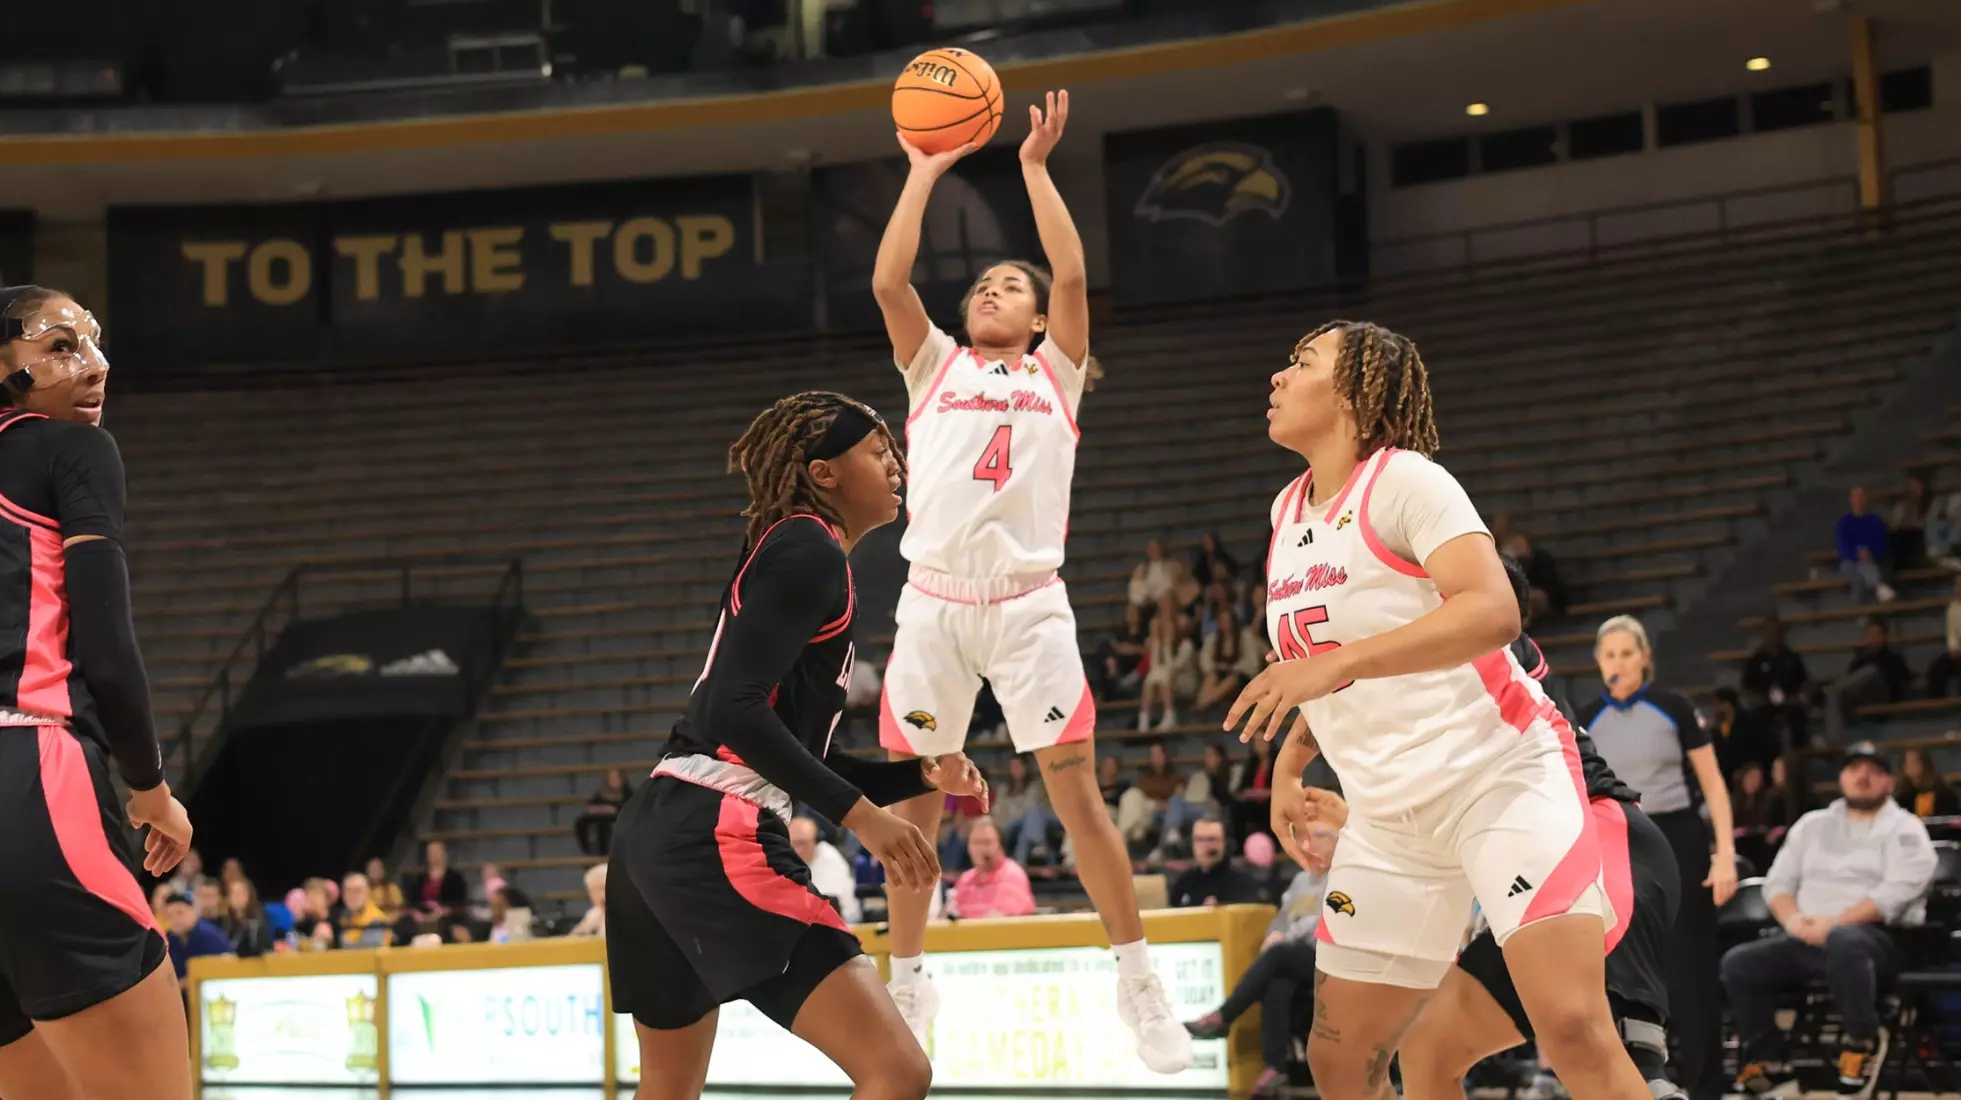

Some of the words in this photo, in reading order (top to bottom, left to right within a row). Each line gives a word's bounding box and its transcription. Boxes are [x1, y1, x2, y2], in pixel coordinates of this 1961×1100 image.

[181, 239, 312, 307] TO
[334, 227, 525, 301] THE
[549, 215, 735, 287] TOP
[937, 390, 1008, 413] Southern
[1011, 389, 1052, 415] Miss
[973, 424, 1013, 493] 4
[1305, 562, 1348, 592] Miss
